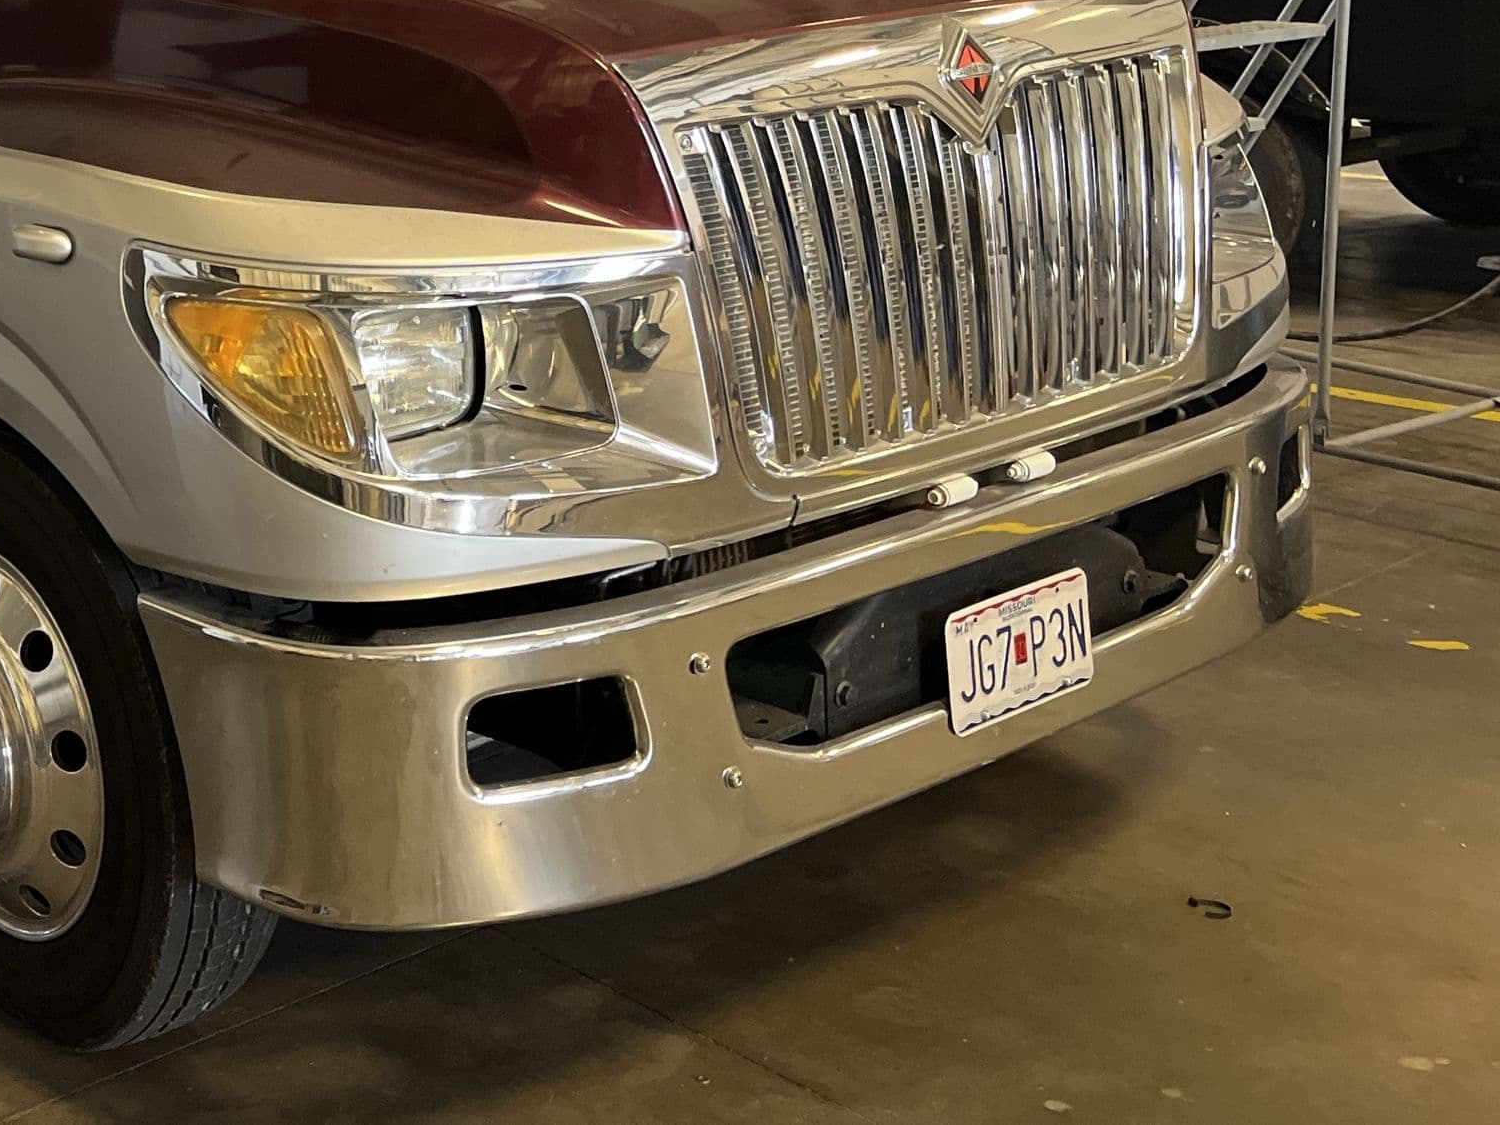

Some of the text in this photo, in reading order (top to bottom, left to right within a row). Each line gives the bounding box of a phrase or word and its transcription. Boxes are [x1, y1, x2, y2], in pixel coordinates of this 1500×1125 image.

[998, 596, 1036, 616] MISSOURI
[961, 598, 1087, 703] JG7 P3N
